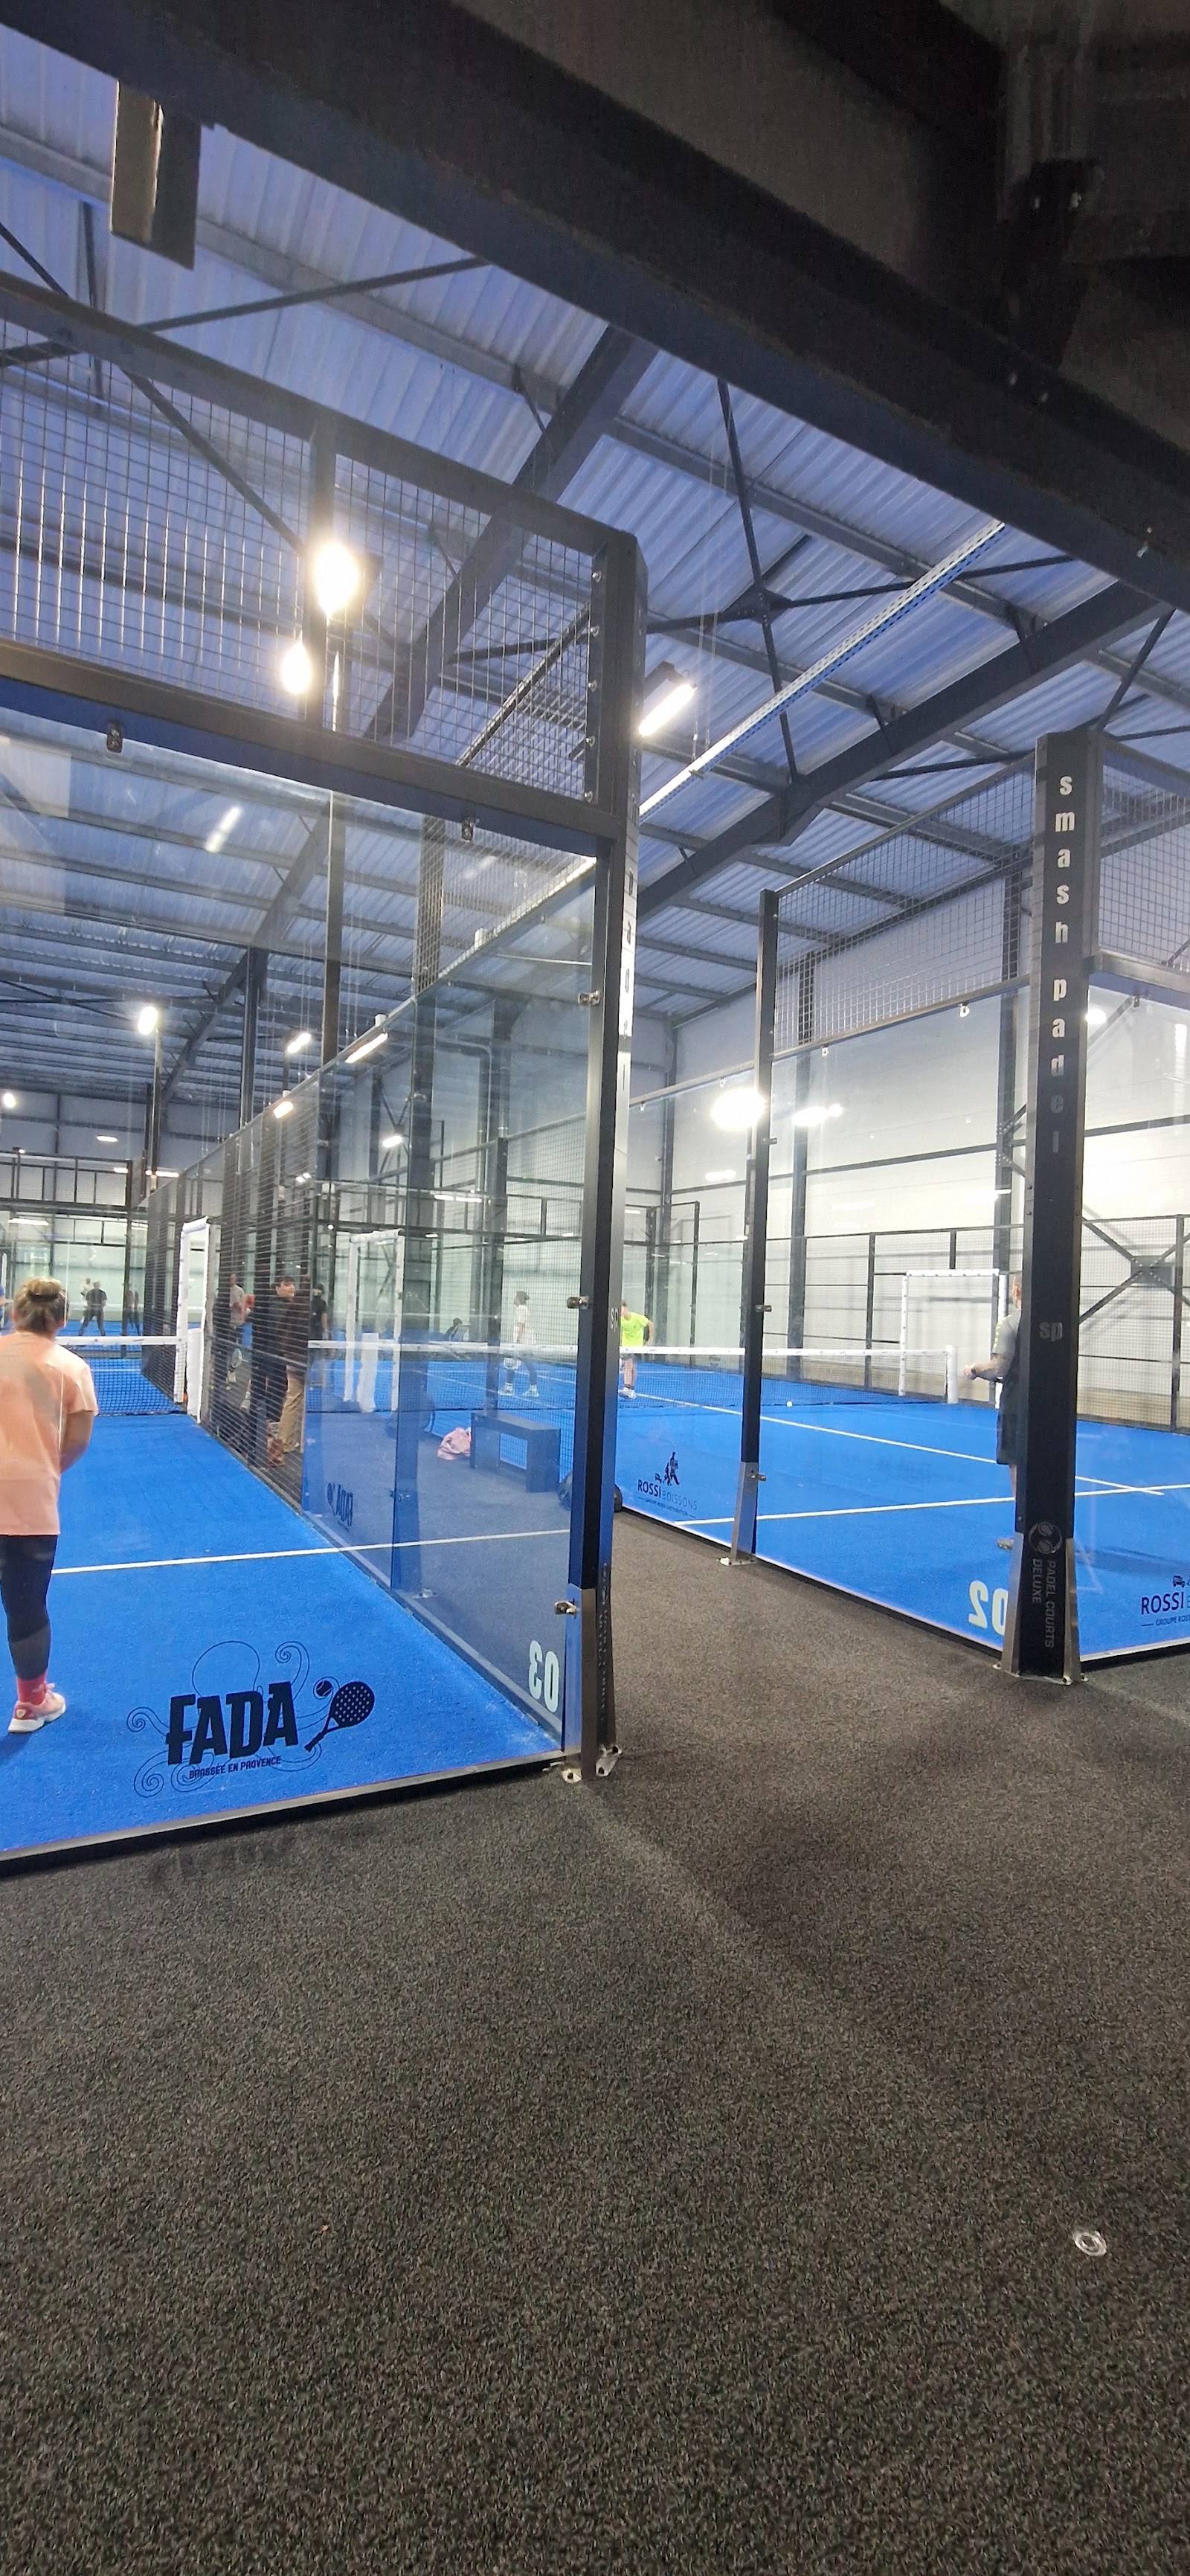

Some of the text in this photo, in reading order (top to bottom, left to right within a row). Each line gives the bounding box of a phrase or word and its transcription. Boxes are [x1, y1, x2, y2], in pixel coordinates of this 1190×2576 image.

[1050, 775, 1075, 1153] smash padel
[1040, 1322, 1063, 1342] sp
[637, 1479, 661, 1498] ROSSI
[662, 1490, 698, 1511] BOISSONS
[1032, 1558, 1043, 1604] DELUXE
[1045, 1559, 1056, 1649] PADEL COURTS
[1141, 1592, 1184, 1615] ROSSI
[166, 1681, 299, 1765] FADA
[228, 1764, 239, 1773] EN
[240, 1756, 281, 1770] PROVENCE
